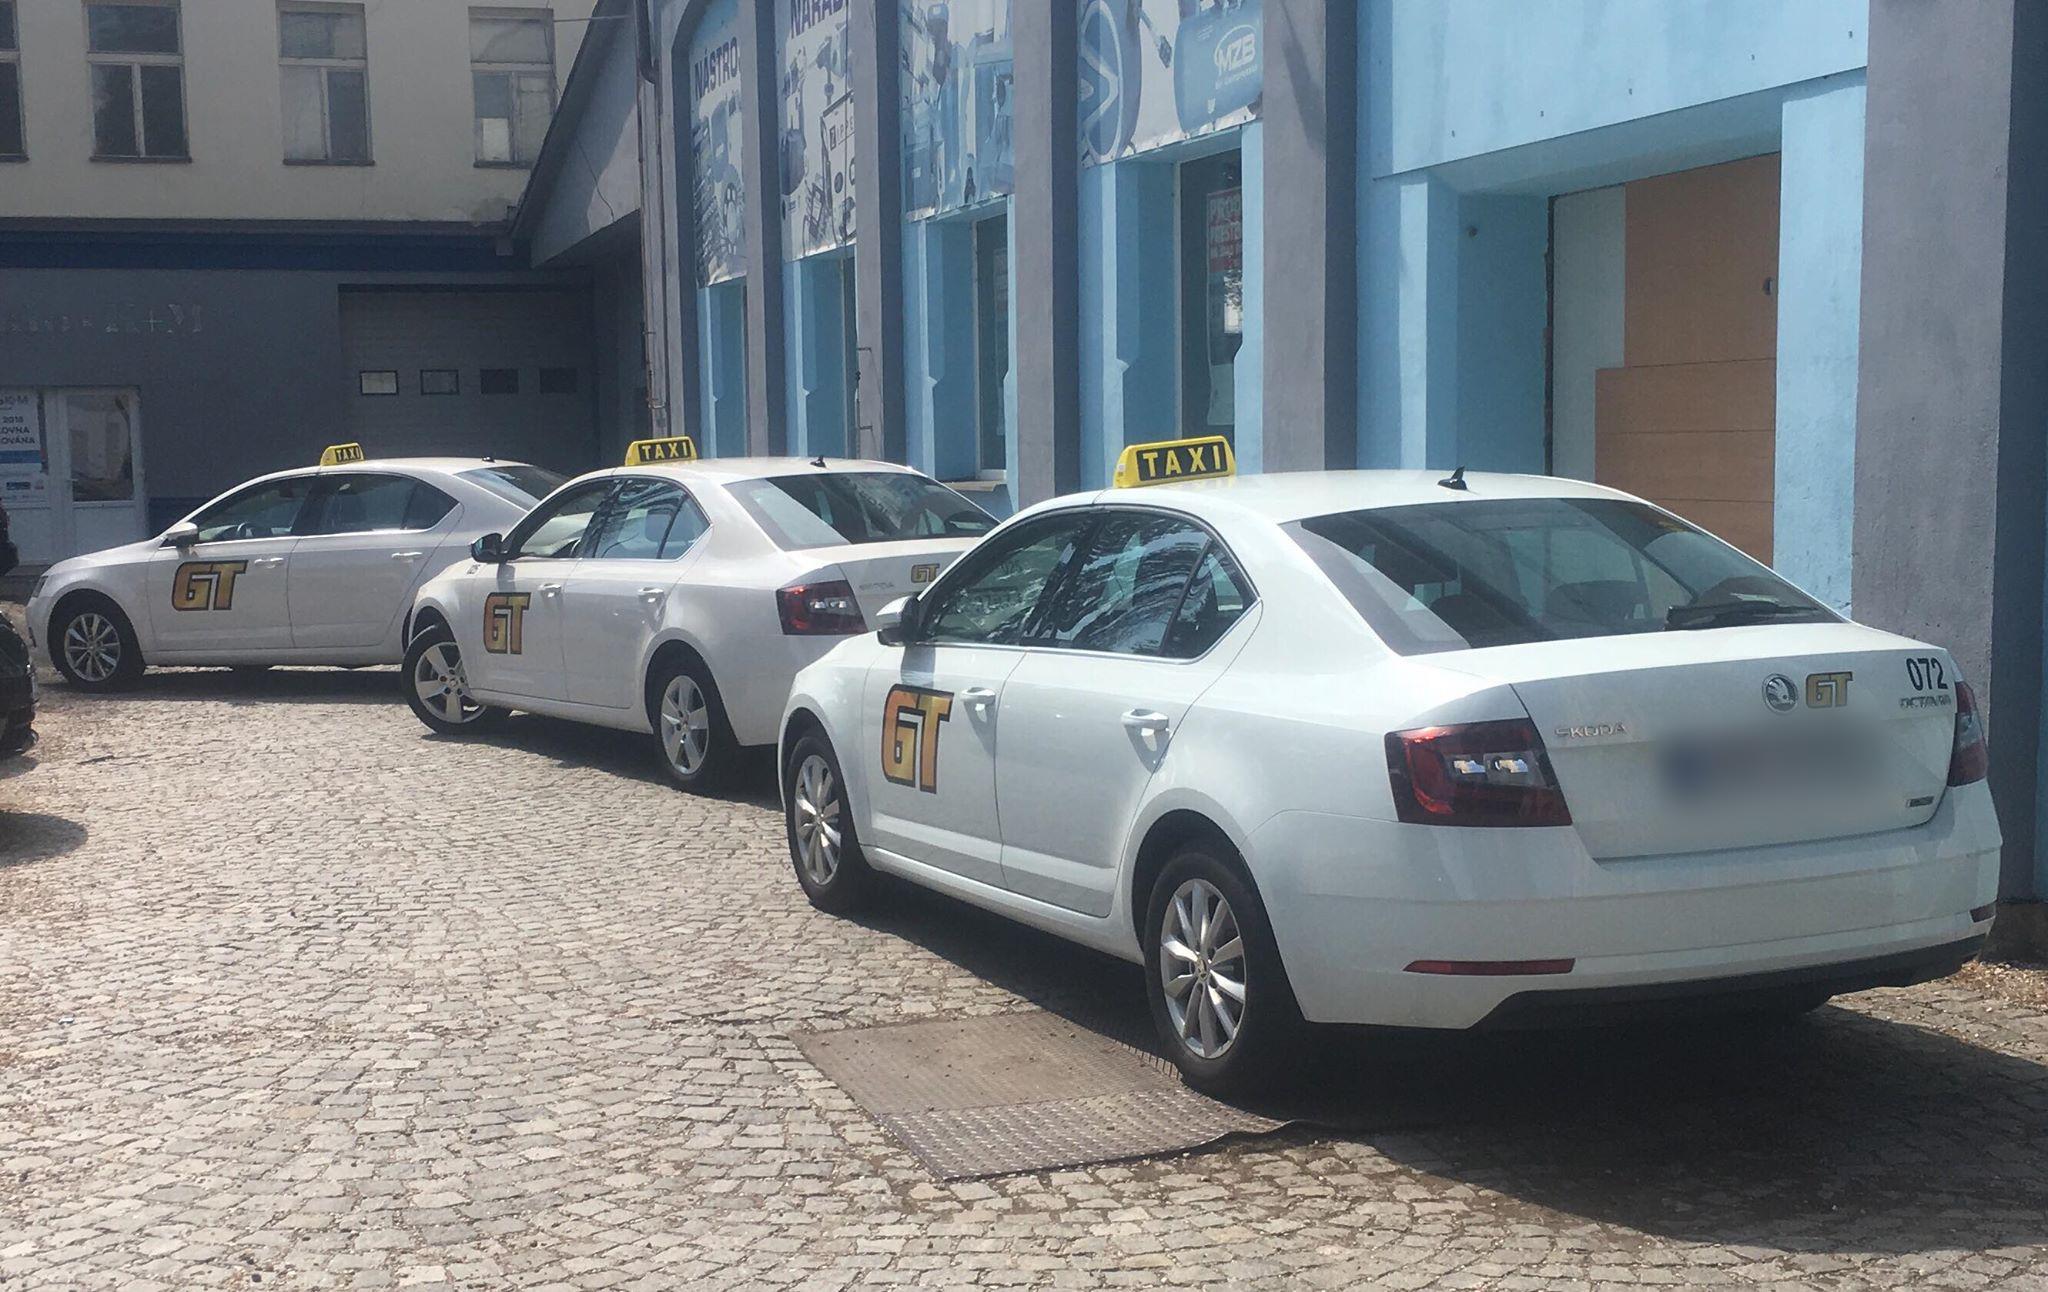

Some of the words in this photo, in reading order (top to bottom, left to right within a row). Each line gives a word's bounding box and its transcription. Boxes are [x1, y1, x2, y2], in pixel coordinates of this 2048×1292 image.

[1218, 33, 1256, 72] MZB
[336, 447, 360, 462] TAXI
[642, 441, 688, 460] TAXI
[1142, 445, 1221, 478] TAXI
[172, 560, 248, 611] GT
[911, 563, 940, 583] GT
[483, 592, 531, 655] GT
[1806, 671, 1853, 708] GT
[1906, 658, 1948, 690] 072
[881, 684, 954, 794] GT
